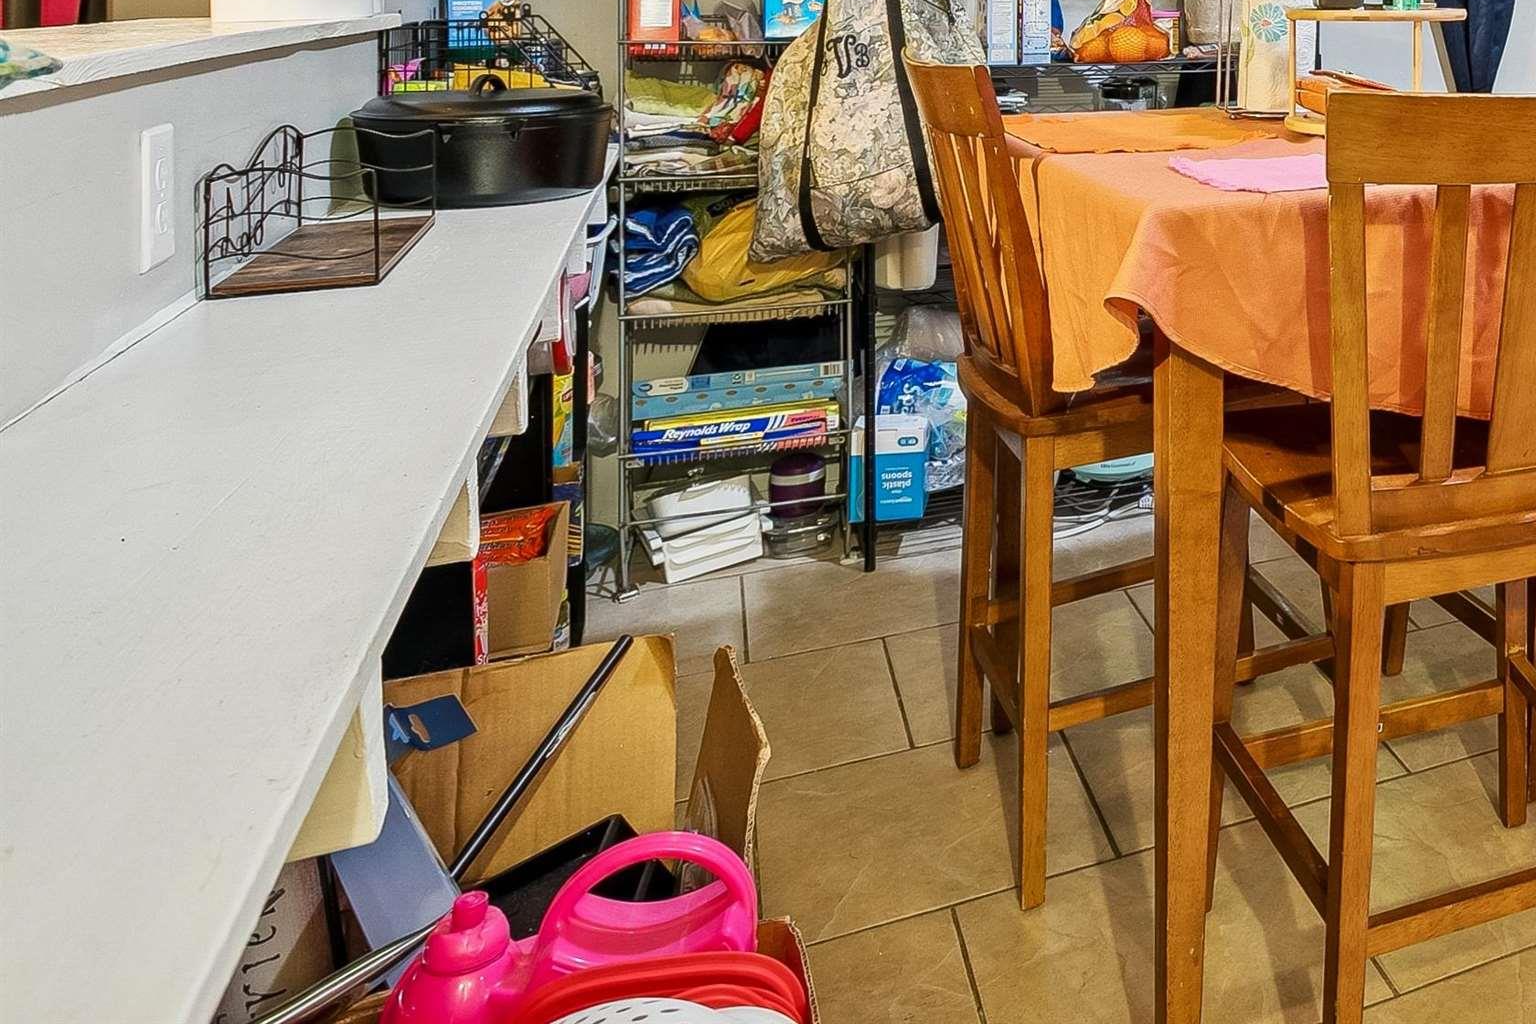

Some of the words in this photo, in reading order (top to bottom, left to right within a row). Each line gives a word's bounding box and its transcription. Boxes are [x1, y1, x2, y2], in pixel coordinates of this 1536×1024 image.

[664, 425, 717, 440] Reynolds
[718, 421, 751, 435] Wrap
[881, 470, 913, 480] spoons
[881, 479, 912, 490] plastic
